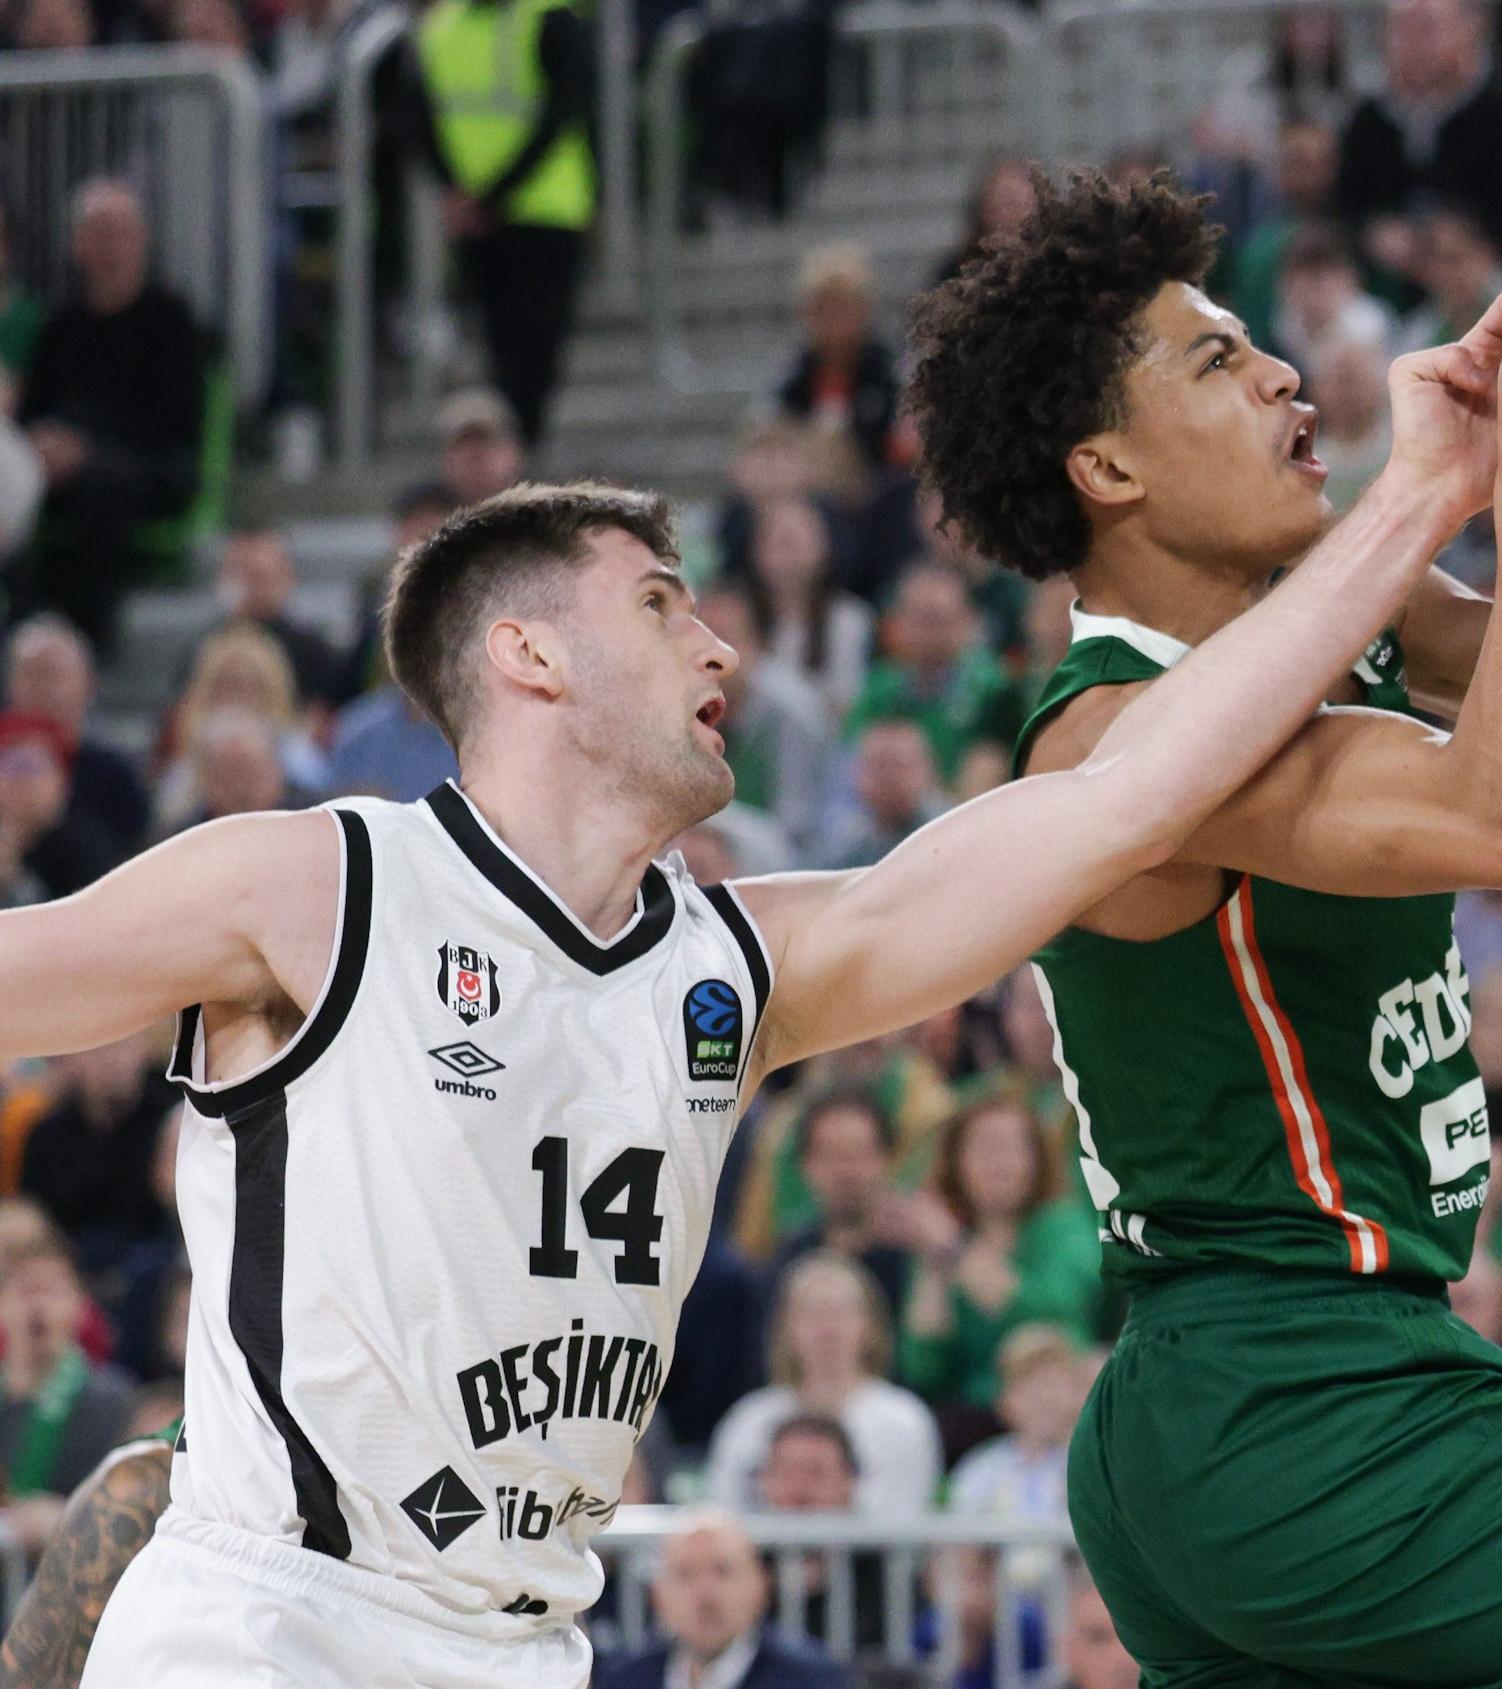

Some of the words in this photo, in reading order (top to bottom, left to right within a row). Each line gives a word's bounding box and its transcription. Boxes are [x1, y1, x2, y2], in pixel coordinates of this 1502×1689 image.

[449, 947, 488, 974] BJK
[451, 1000, 488, 1019] 1903
[1368, 912, 1472, 1099] CEDE
[692, 1062, 736, 1077] EuroCup
[434, 1078, 498, 1101] umbro
[1445, 1103, 1489, 1151] PE
[529, 1135, 666, 1287] 14
[456, 1317, 664, 1451] BEŞİKTA
